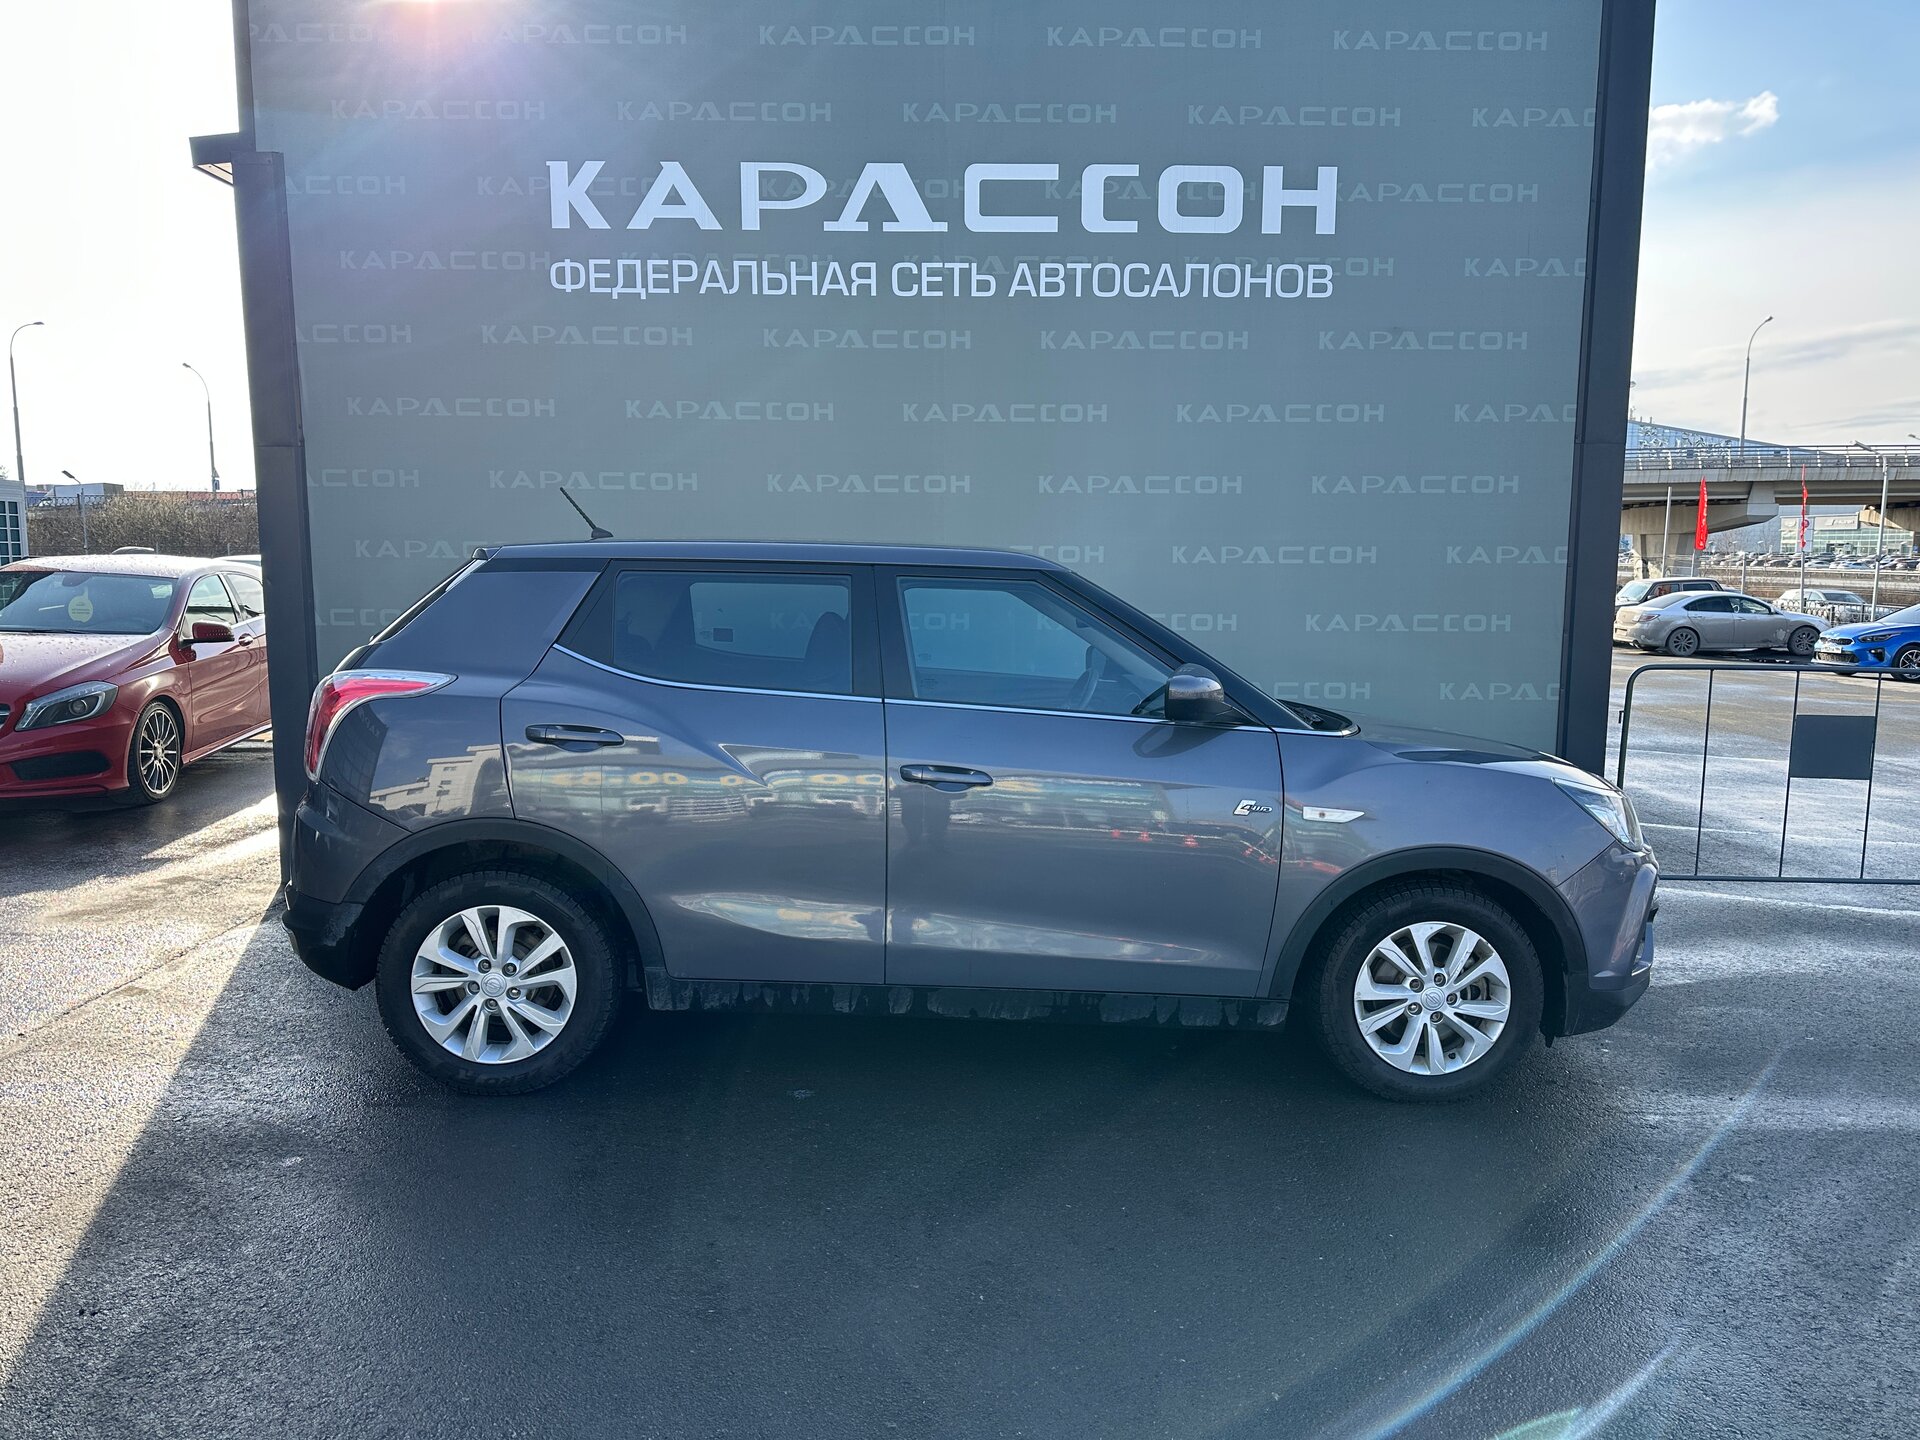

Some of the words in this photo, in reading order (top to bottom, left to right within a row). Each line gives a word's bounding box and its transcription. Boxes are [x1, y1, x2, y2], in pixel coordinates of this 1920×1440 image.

[549, 258, 877, 300] ФЕДЕРАЛЬНАЯ
[891, 262, 996, 298] СЕТЬ
[1007, 262, 1334, 299] АВТОСАЛОНОВ
